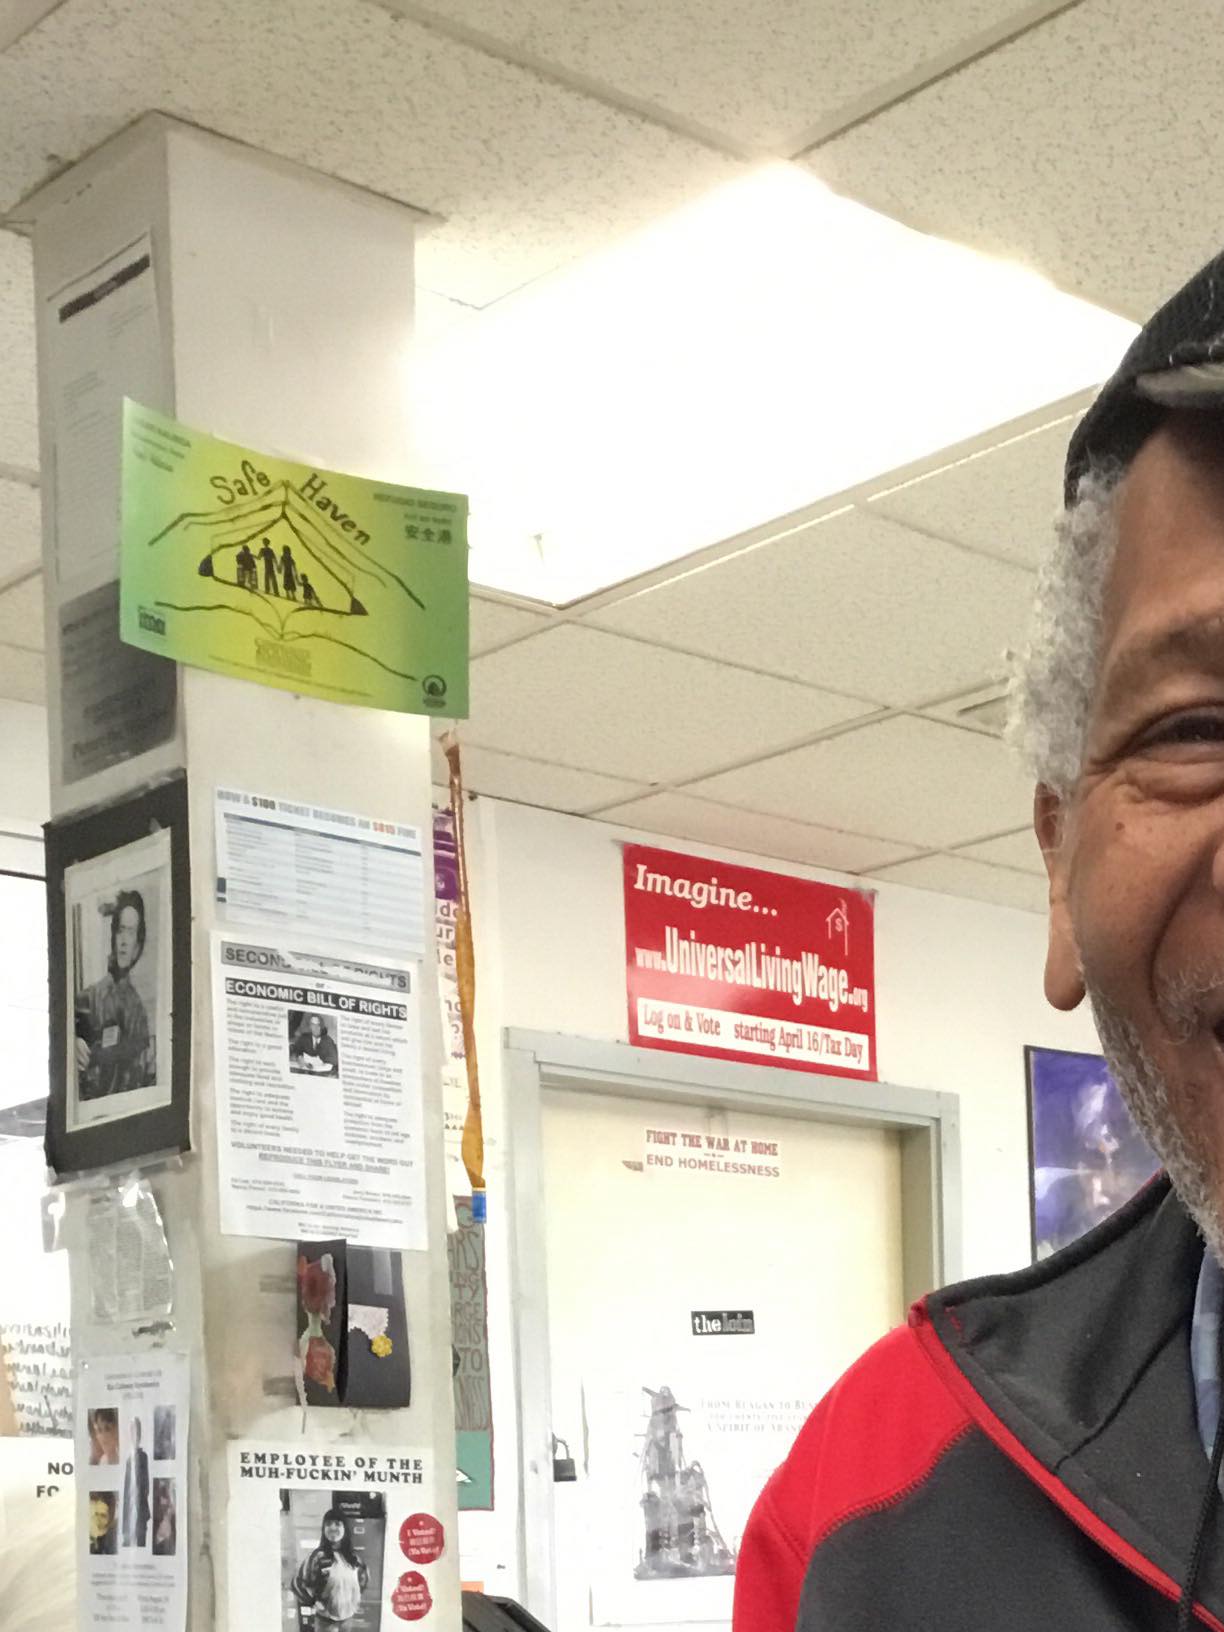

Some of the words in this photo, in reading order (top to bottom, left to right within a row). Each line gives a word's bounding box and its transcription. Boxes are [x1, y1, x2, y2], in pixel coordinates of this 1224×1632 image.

[209, 460, 271, 505] Safe
[300, 473, 371, 546] Haven
[634, 864, 778, 916] Imagine...
[635, 926, 868, 1013] www.UniversalLivingWage.org
[225, 979, 304, 1002] ECONOMIC
[307, 993, 336, 1008] BILL
[339, 998, 355, 1010] OF
[359, 1000, 407, 1018] RIGHTS
[644, 1005, 664, 1034] Log
[667, 1013, 682, 1030] on
[685, 1011, 693, 1029] &
[697, 1012, 721, 1036] Vote
[734, 1023, 776, 1050] starting
[778, 1028, 803, 1052] April
[807, 1031, 842, 1056] 16/Tax
[845, 1038, 864, 1064] Day
[646, 1130, 677, 1146] FIGHT
[681, 1133, 702, 1148] THE
[705, 1136, 730, 1151] WAR
[734, 1139, 747, 1153] AT
[751, 1141, 778, 1156] HOME
[646, 1154, 674, 1168] END
[678, 1157, 780, 1178] HOMELESSNESS
[240, 1452, 346, 1467] EMPLOYEE
[354, 1457, 378, 1469] OF
[387, 1458, 423, 1471] THE
[240, 1466, 357, 1481] MUH-FUCKIN'
[364, 1470, 423, 1484] MUNTH
